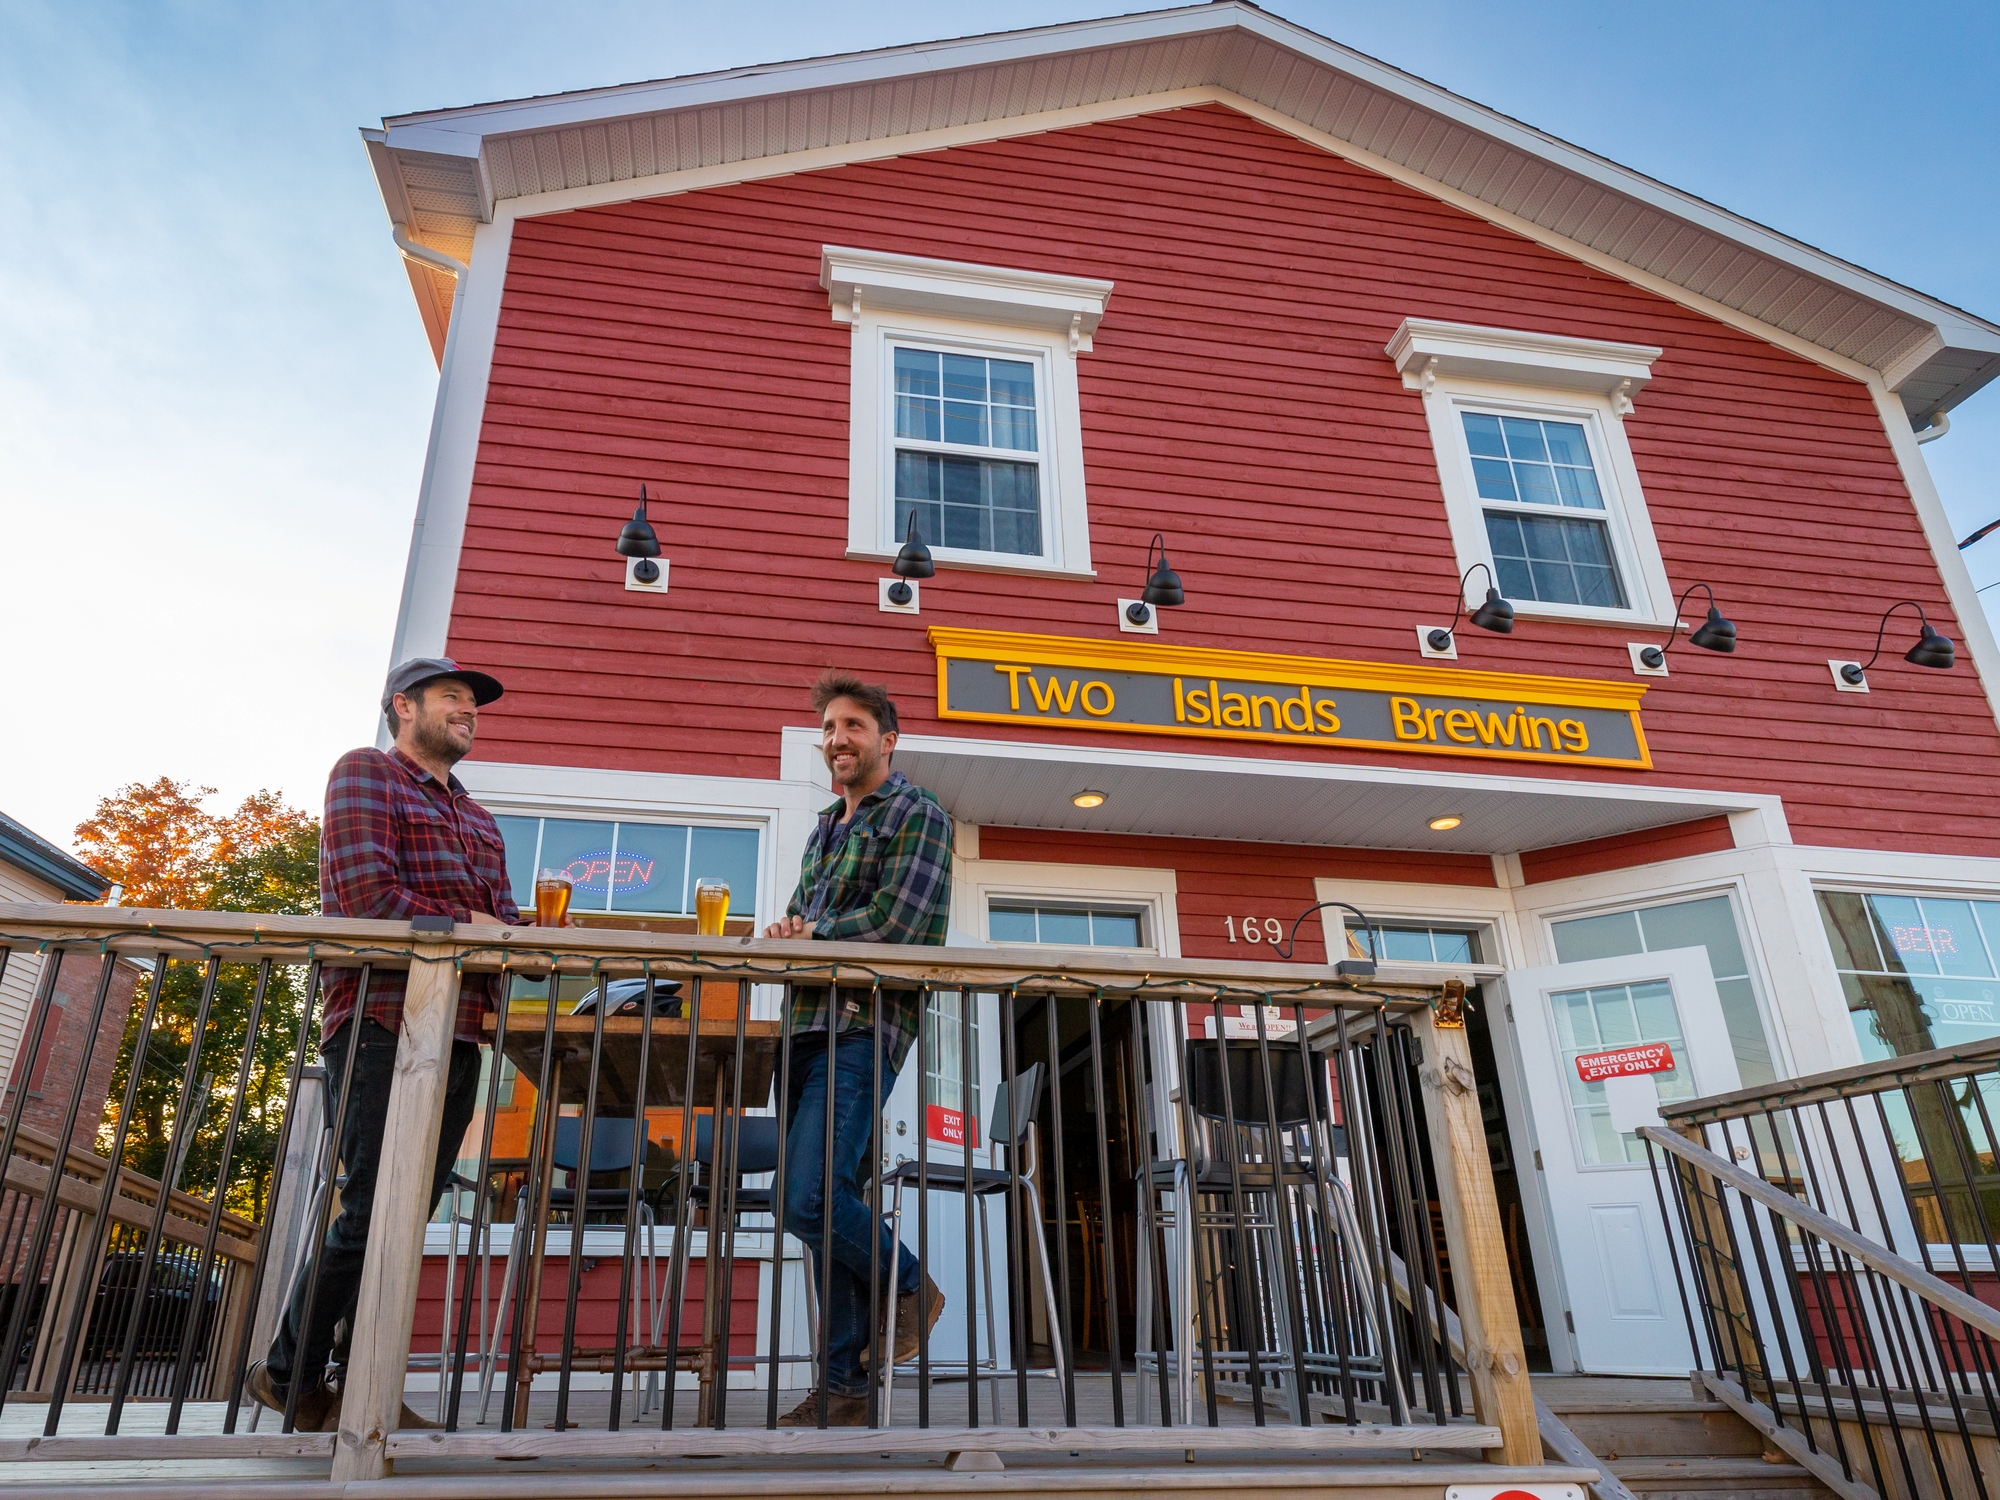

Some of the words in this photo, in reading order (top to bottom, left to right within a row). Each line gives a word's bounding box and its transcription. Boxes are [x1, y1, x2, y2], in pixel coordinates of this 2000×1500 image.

[994, 664, 1115, 716] Two
[1172, 677, 1341, 734] Islands
[1390, 696, 1590, 752] Brewing
[562, 860, 654, 882] OPEN
[1224, 915, 1283, 945] 169
[1893, 926, 1957, 953] BEER
[1942, 1003, 1995, 1022] OPEN
[1580, 1048, 1665, 1068] EMERGENCY
[1589, 1065, 1620, 1077] EXIT
[1624, 1058, 1661, 1072] ONLY
[943, 1114, 961, 1126] EXIT
[942, 1127, 963, 1139] ONLY
